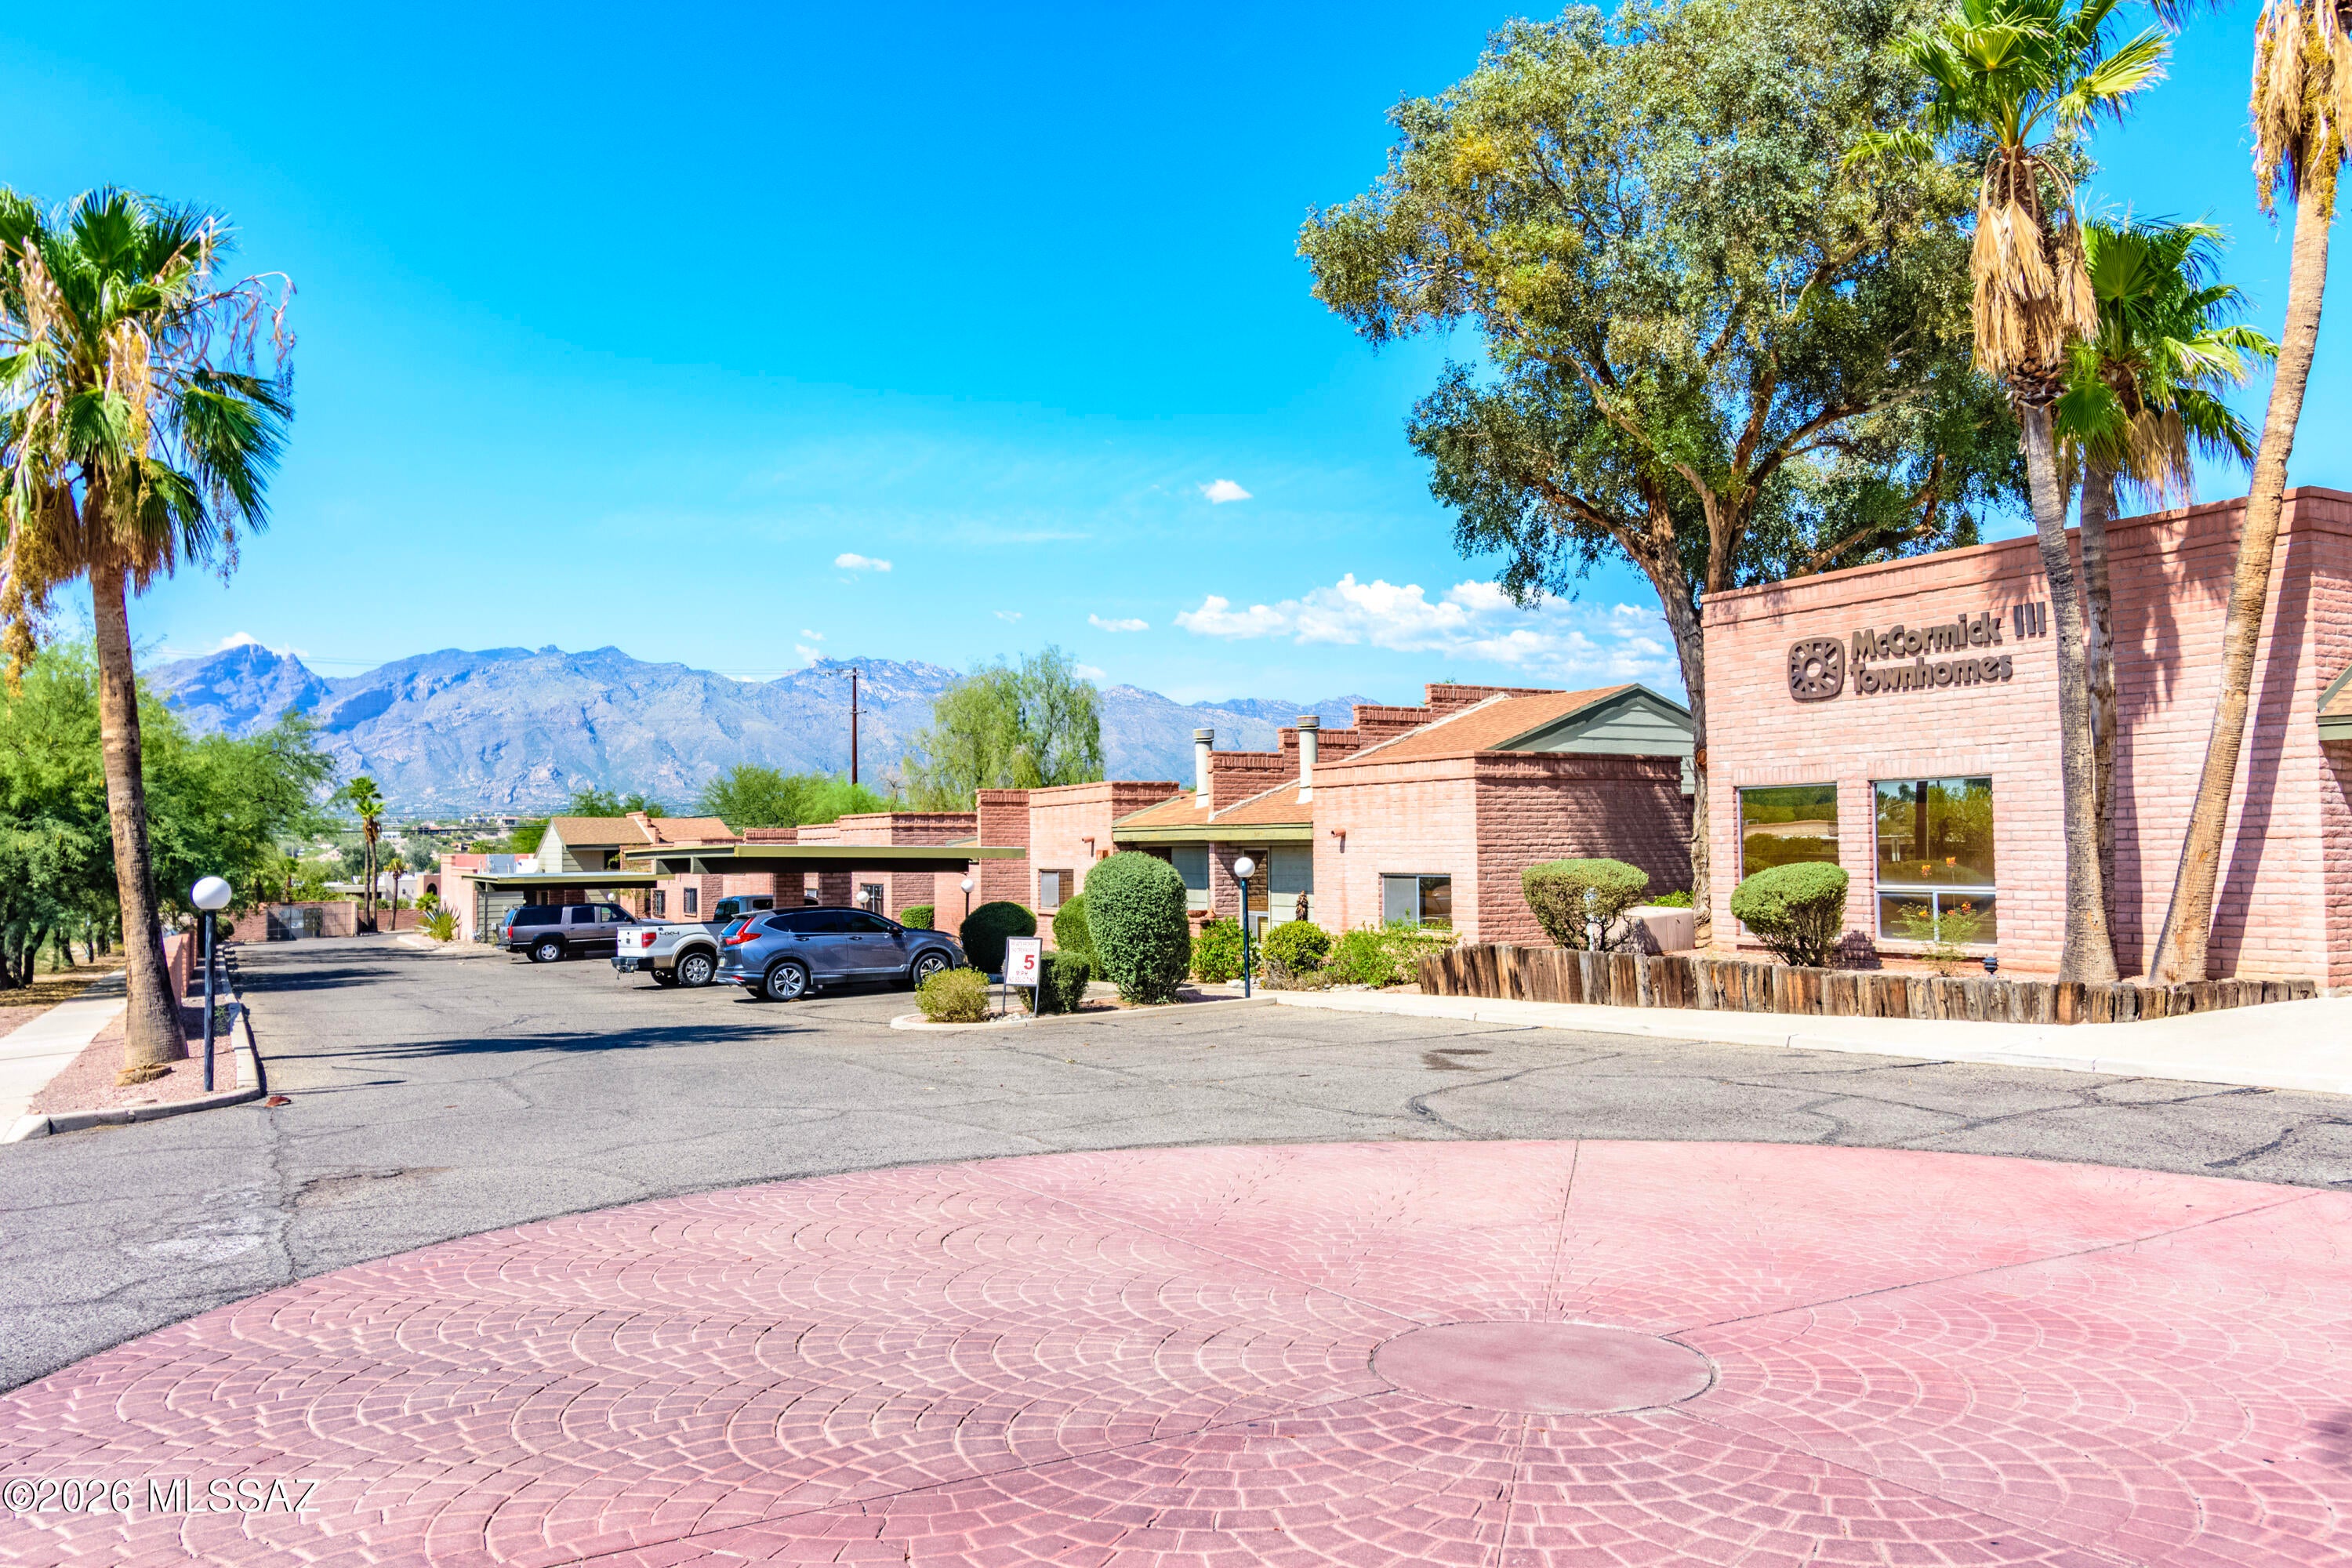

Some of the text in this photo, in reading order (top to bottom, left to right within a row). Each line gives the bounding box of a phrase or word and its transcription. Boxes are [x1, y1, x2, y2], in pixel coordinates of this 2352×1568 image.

[1851, 601, 2047, 659] McCormick III
[1849, 656, 2013, 693] Townhomes
[1024, 954, 1035, 970] 5
